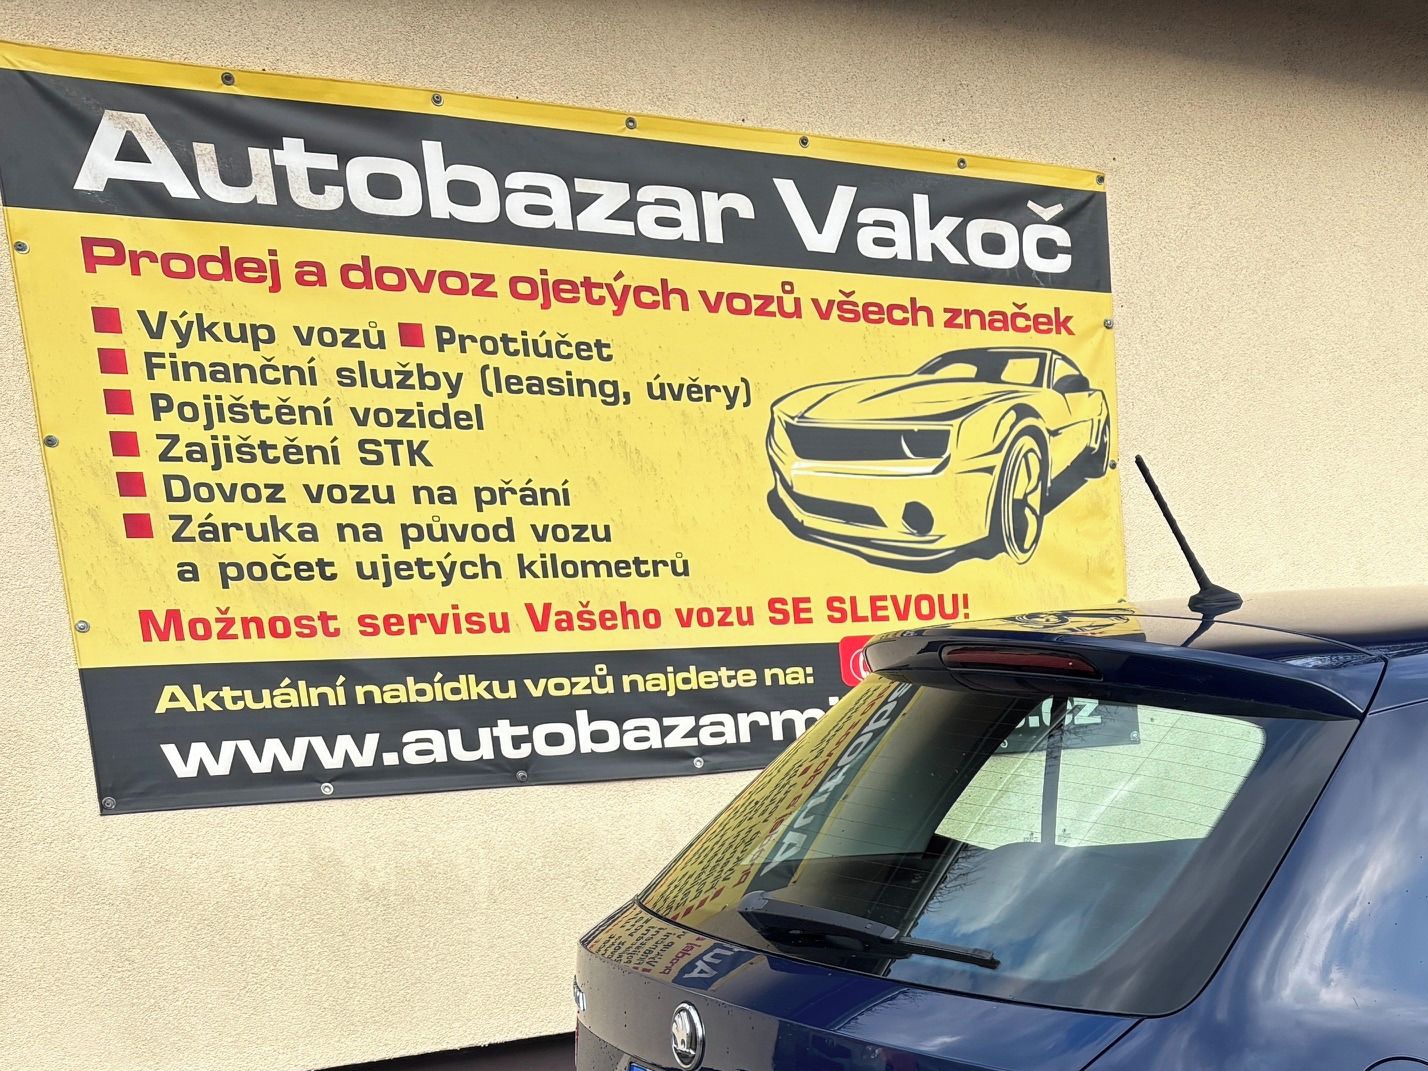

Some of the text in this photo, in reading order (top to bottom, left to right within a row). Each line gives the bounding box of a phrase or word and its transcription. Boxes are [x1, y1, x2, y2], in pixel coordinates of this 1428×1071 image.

[73, 110, 1071, 273] Autobazar Vakoč
[80, 237, 1075, 336] Prodej a dovoz ojetých vozů všech značek
[137, 310, 613, 361] Výkup vozů Protiúčet
[144, 352, 750, 410] Finanční služby (leasing, úvěry)
[151, 393, 483, 430] Pojištění vozidel
[156, 434, 433, 470] Zajištění STK
[163, 475, 570, 512] Dovoz vozu na přání
[169, 513, 611, 549] Záruka na původ vozu
[177, 551, 689, 589] a počet ujetých kilometrů
[139, 594, 969, 642] Možnost servisu Vašeho vozu SE SLEVOU!
[154, 665, 814, 713] Aktuální nabídku vozů najdete na:
[160, 697, 838, 778] www.autobazarm
